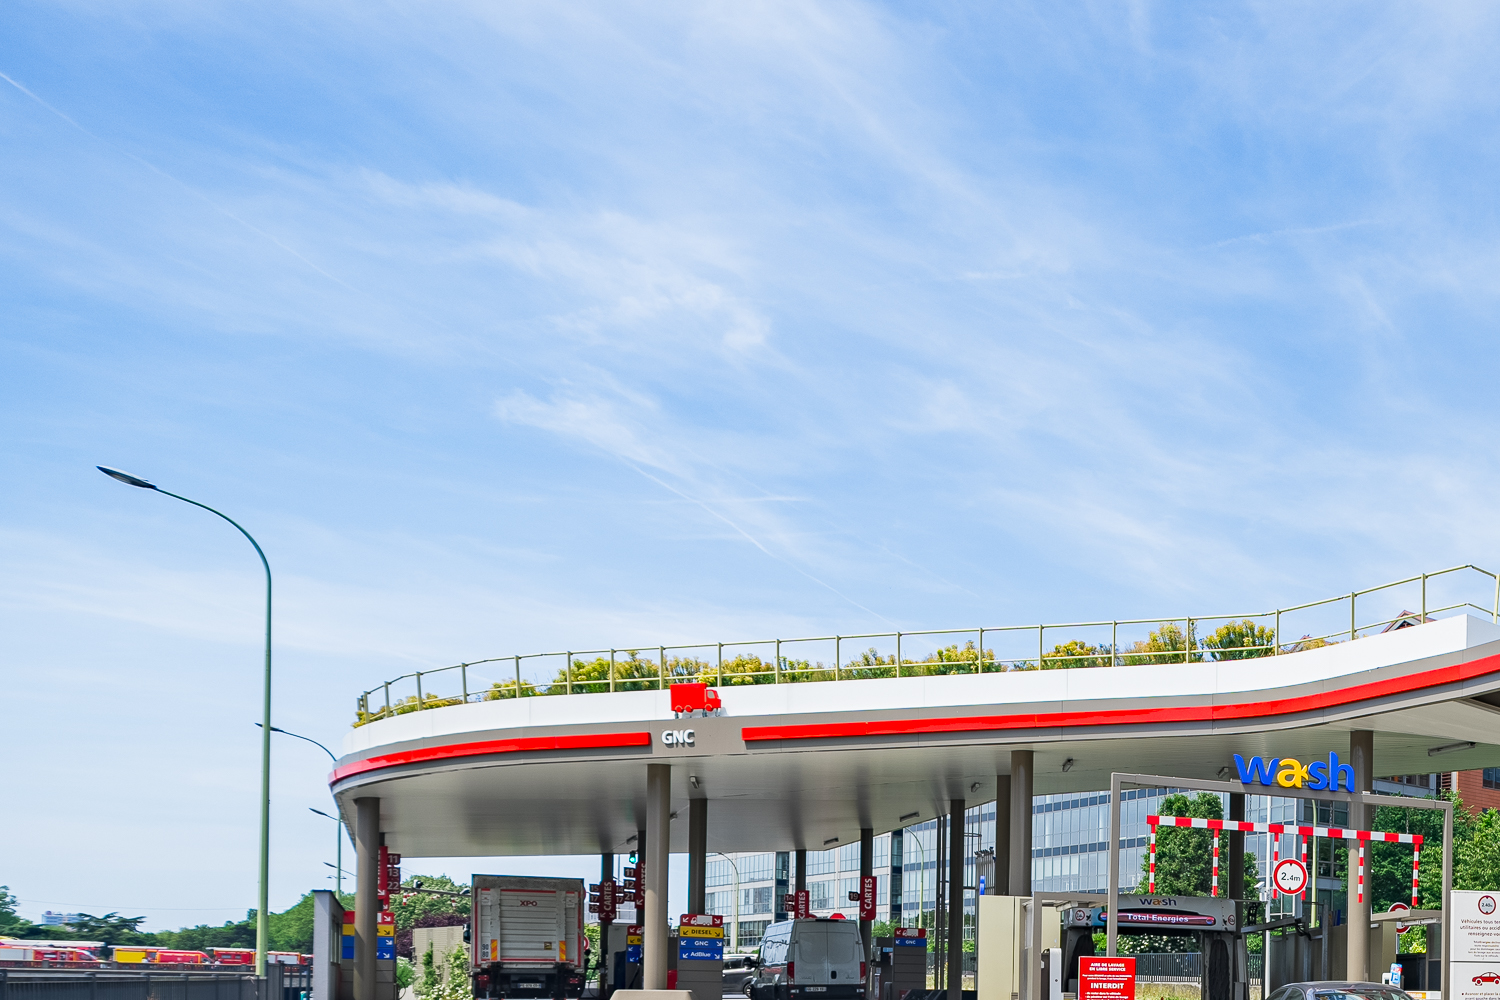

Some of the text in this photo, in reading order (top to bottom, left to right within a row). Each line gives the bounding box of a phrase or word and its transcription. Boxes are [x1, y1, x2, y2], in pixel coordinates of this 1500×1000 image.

[661, 729, 695, 744] GNC
[1233, 751, 1355, 793] wash
[387, 868, 399, 876] 13
[1281, 872, 1300, 881] 2.4m
[387, 882, 399, 890] 22
[604, 881, 612, 911] CARTES
[864, 878, 873, 910] CARTES
[798, 892, 806, 919] CARTES
[1138, 897, 1177, 906] wash
[1127, 913, 1189, 924] Total Energies
